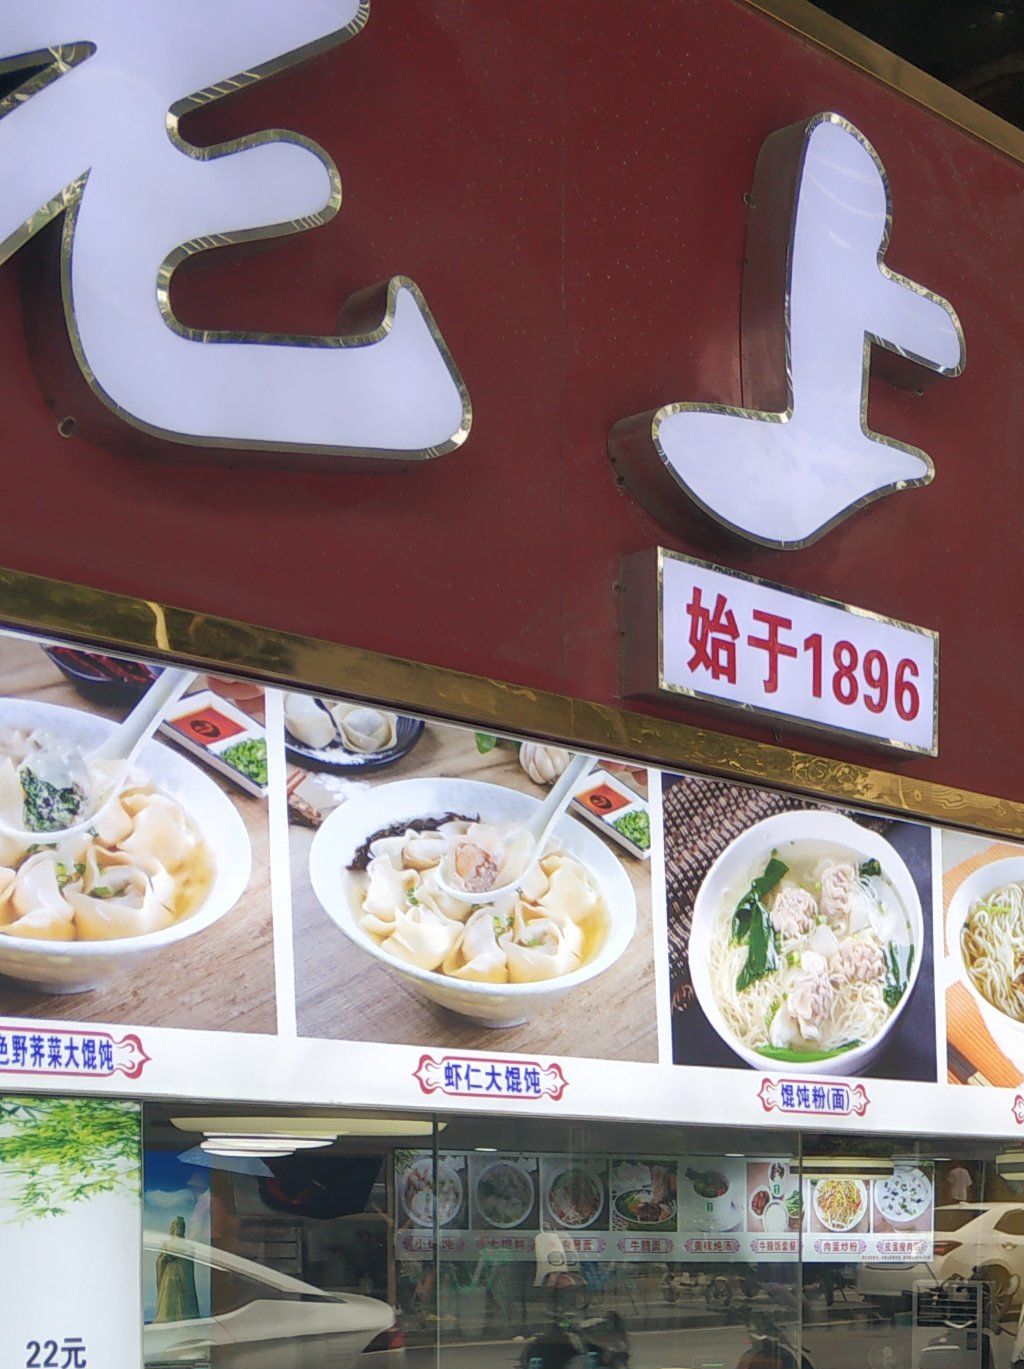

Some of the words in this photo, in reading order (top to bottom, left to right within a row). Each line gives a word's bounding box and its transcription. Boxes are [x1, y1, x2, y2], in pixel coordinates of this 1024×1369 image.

[686, 586, 921, 723] 始于1896
[444, 1061, 541, 1095] 虾仁大馄饨
[781, 1083, 850, 1112] 馄饨粉(面)
[630, 1239, 662, 1253] 牛腩面
[823, 1241, 858, 1253] 肉蛋炒粉
[26, 1337, 88, 1369] 22元
